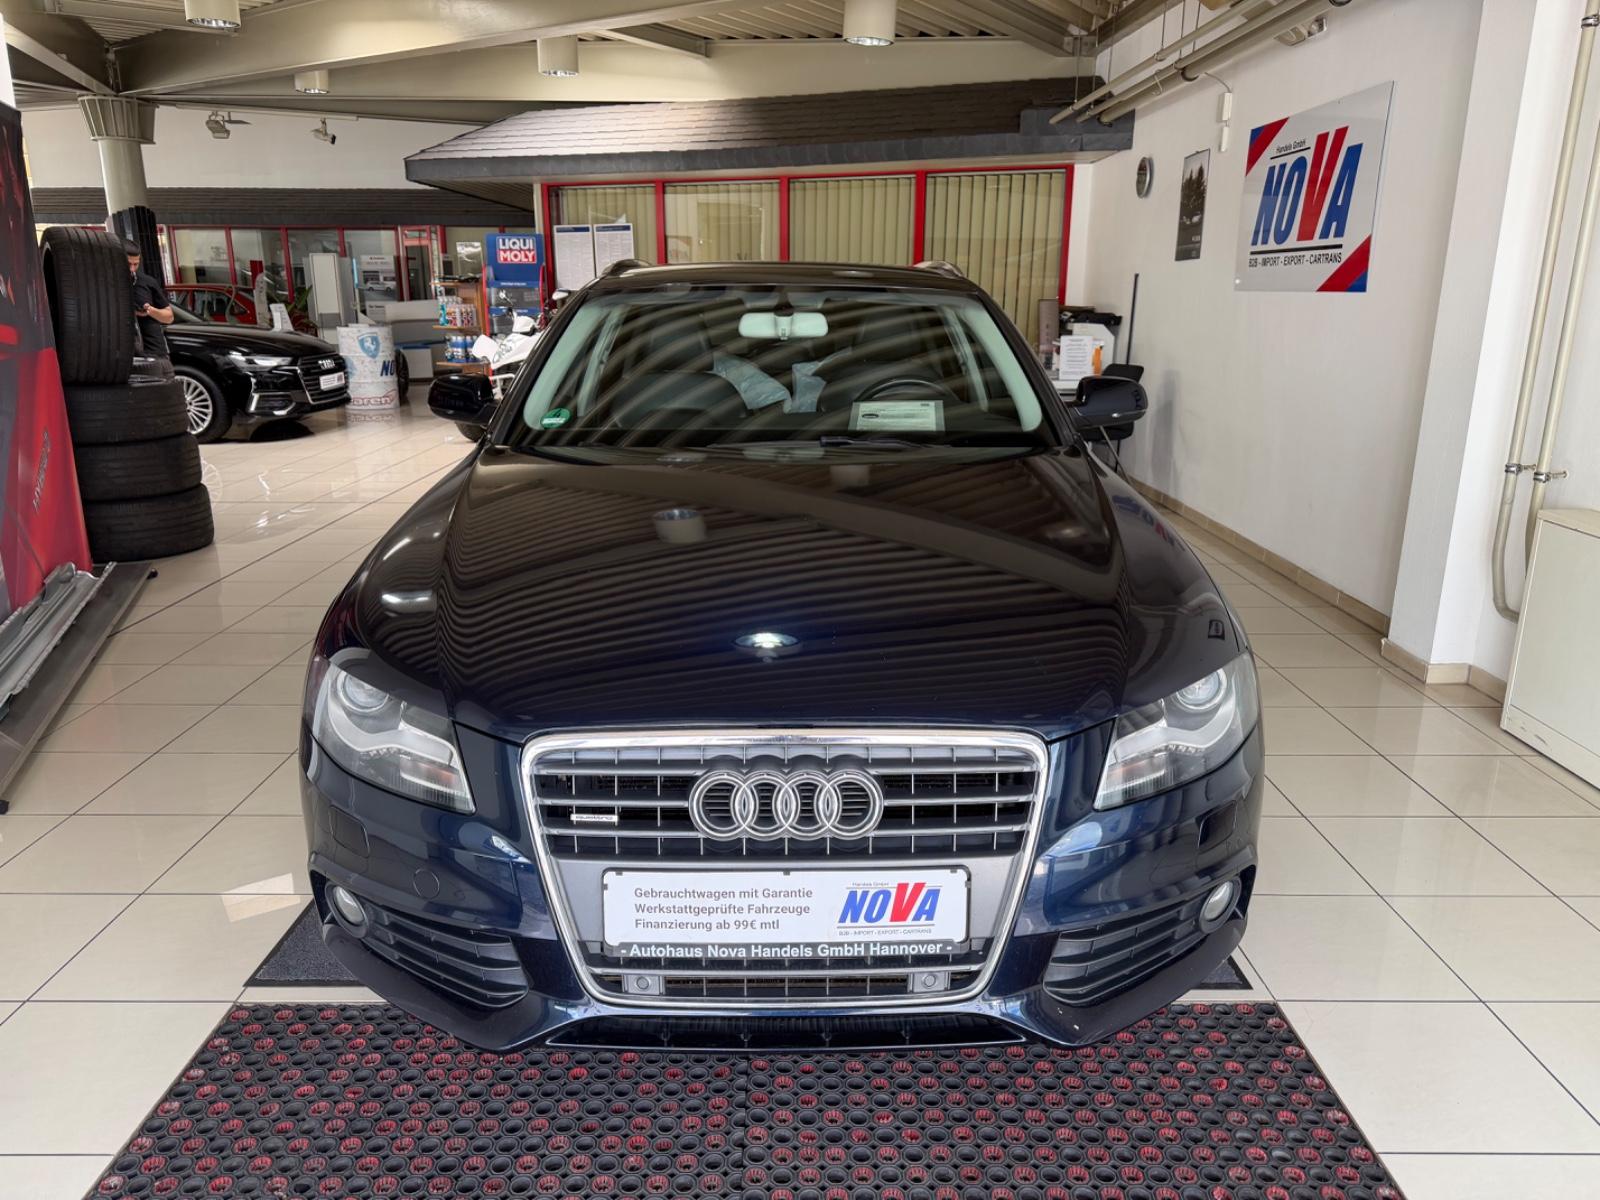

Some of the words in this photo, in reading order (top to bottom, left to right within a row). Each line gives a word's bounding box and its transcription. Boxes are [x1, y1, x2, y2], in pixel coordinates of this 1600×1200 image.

[1251, 126, 1364, 246] NOVA
[500, 238, 533, 250] LIQUI
[500, 250, 535, 262] MOLY
[1261, 257, 1280, 267] IMPORT
[1283, 255, 1305, 266] EXPORT
[1309, 252, 1342, 265] CARTRANS
[634, 887, 736, 901] Gebrauchtwagen
[739, 888, 759, 899] mit
[762, 887, 813, 899] Garantie
[634, 903, 744, 917] Werkstattgeprüfte
[747, 903, 810, 916] Fahrzeuge
[838, 882, 941, 924] NOVA
[635, 918, 712, 932] Finanzierung
[716, 919, 730, 930] ab
[734, 919, 757, 930] 99€
[760, 919, 779, 930] mtl
[629, 944, 703, 958] Autohaus
[707, 944, 746, 958] Nova
[751, 944, 813, 957] Handels
[817, 943, 864, 957] GmbH
[870, 942, 942, 956] Hannover
